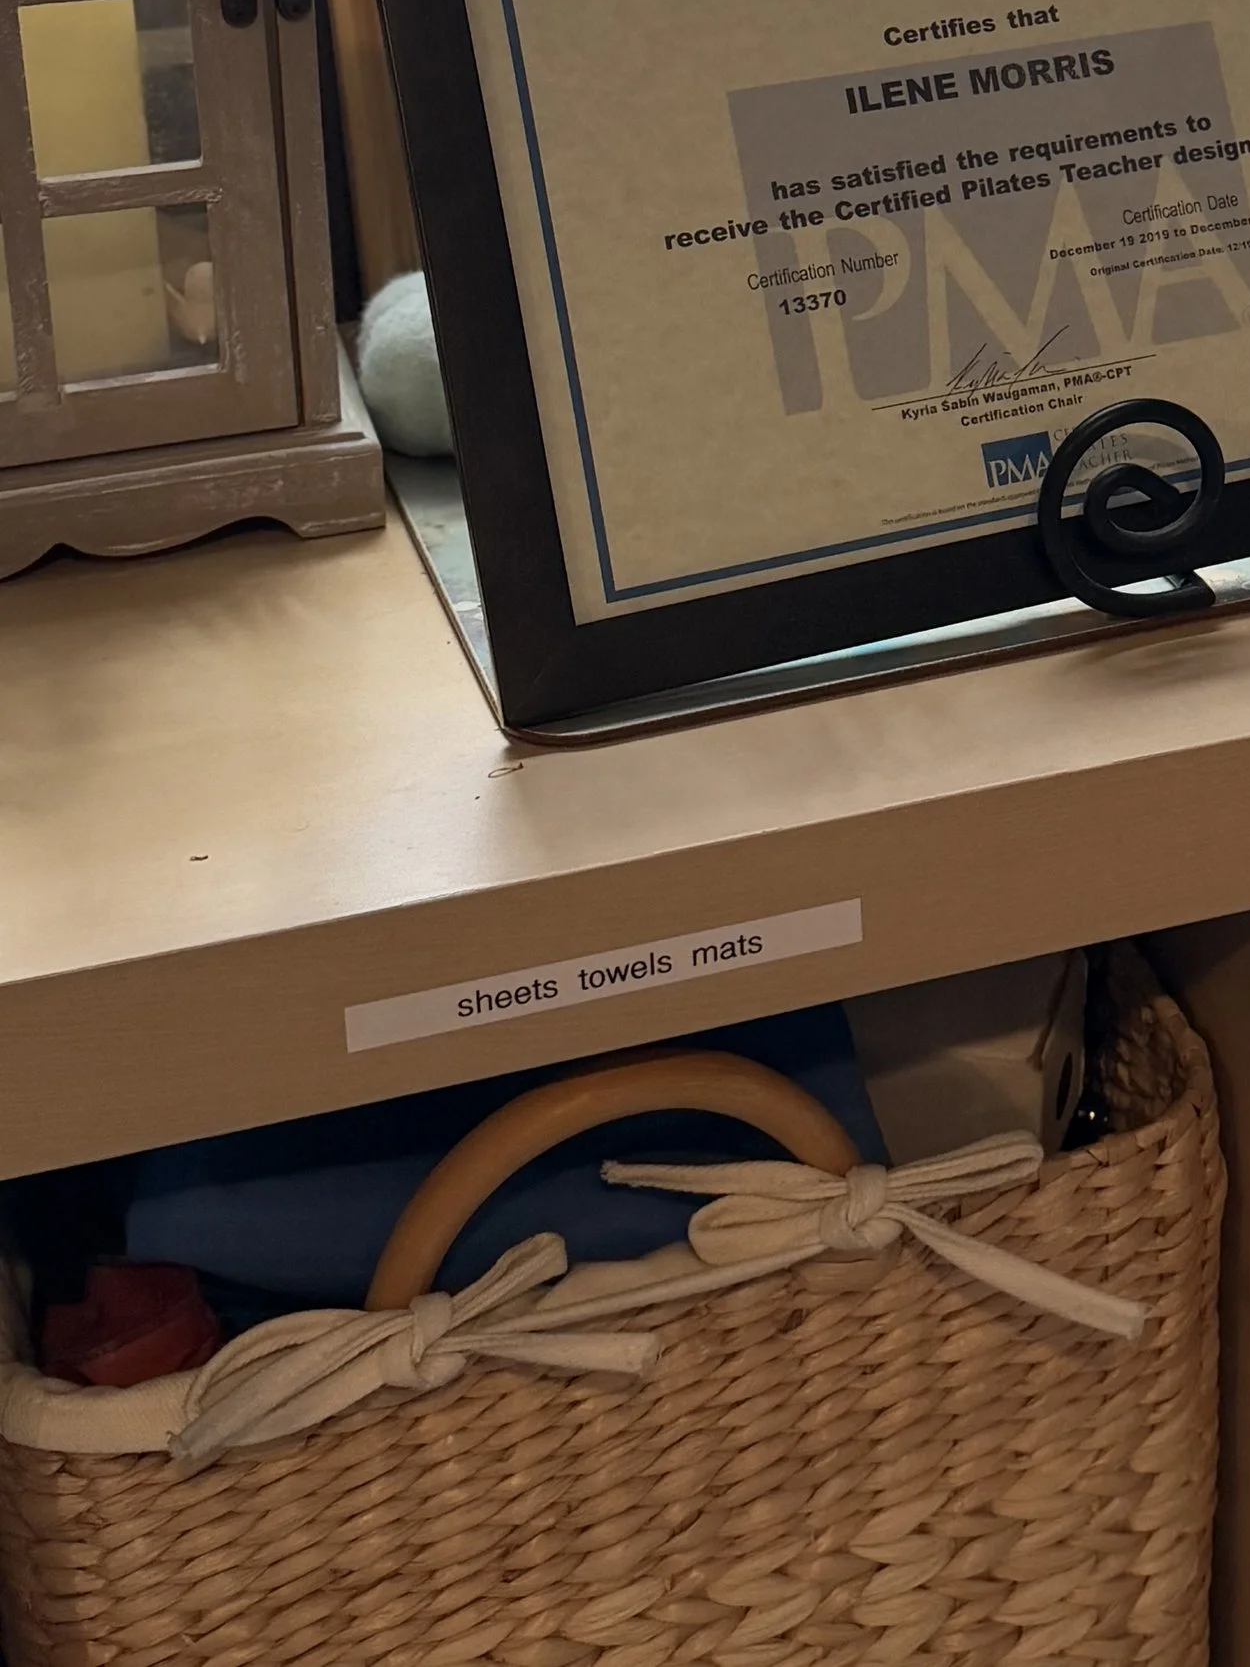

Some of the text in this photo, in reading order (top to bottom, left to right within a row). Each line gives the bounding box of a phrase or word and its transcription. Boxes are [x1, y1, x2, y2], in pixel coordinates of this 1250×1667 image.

[884, 4, 1060, 46] Certifies that
[846, 48, 1115, 114] ILENE MORRIS
[771, 114, 1212, 201] has satisfied the requirements to
[664, 218, 768, 250] receive
[779, 206, 824, 231] the
[835, 184, 952, 221] Certified
[961, 169, 1051, 200] Pilates
[1059, 151, 1164, 184] Teacher
[1122, 193, 1239, 225] Certification Date
[1049, 238, 1116, 260] December
[1119, 235, 1135, 248] 19
[1140, 228, 1170, 245] 2019
[1174, 226, 1187, 238] to
[747, 250, 900, 291] Certification Number
[1090, 261, 1130, 278] Original
[1133, 251, 1196, 270] Certification
[779, 288, 847, 316] 13370
[901, 403, 938, 422] Kyria
[941, 394, 979, 413] Sabin
[982, 381, 1061, 406] Waugaman,
[961, 393, 1084, 428] Certification Chair
[457, 933, 763, 1018] sheets towels mats
